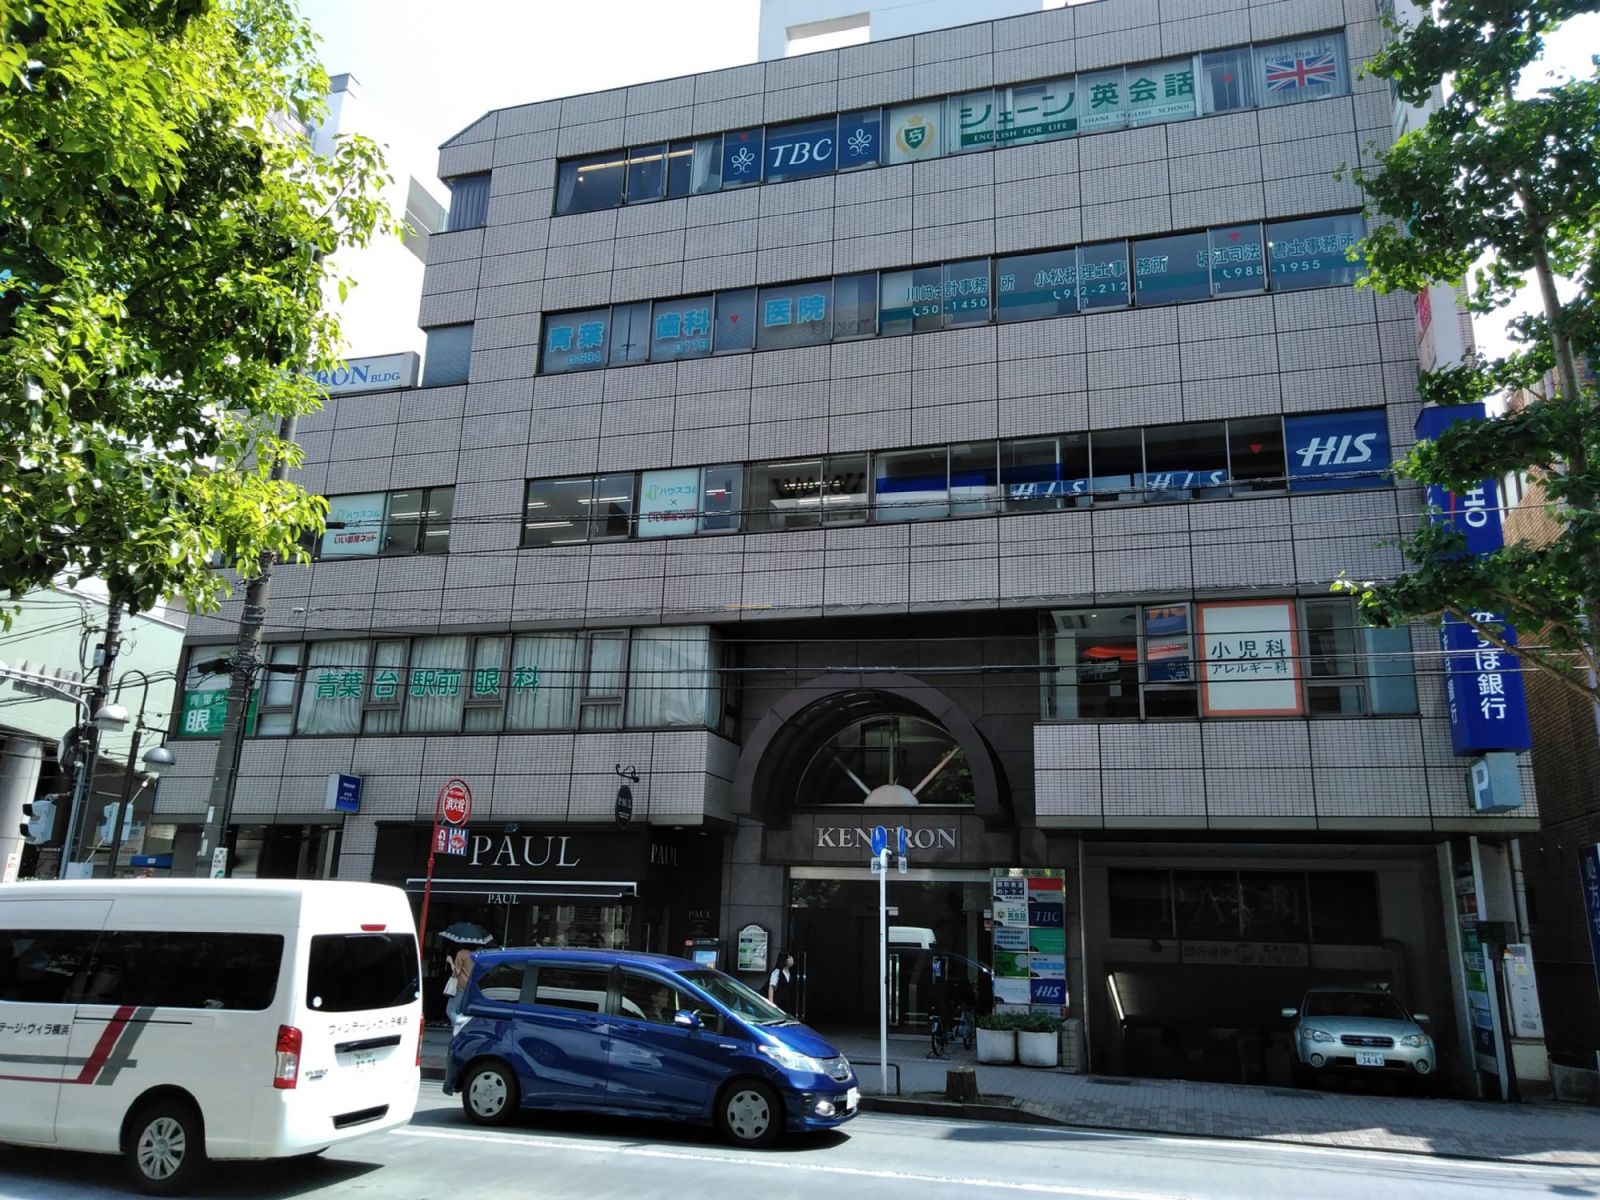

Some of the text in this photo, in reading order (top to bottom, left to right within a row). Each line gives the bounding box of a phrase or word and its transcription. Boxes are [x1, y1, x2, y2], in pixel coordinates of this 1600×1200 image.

[1084, 115, 1110, 124] SHANE
[1158, 103, 1191, 114] SCHOOL
[974, 122, 1068, 142] ENGLISH FOR LIFE
[769, 138, 833, 168] TBC
[764, 294, 826, 328] 医院
[921, 297, 988, 315] 50-1450
[307, 364, 370, 386] RON
[1211, 638, 1287, 659] 小児科
[1211, 658, 1288, 676] アレルギー科
[316, 664, 541, 700] 青葉台駅前眼科
[185, 708, 211, 733] 眼
[1473, 764, 1489, 811] P
[469, 834, 580, 868] PAUL
[651, 843, 680, 866] PAUL
[487, 893, 520, 905] PAUL
[1035, 911, 1061, 922] TBC
